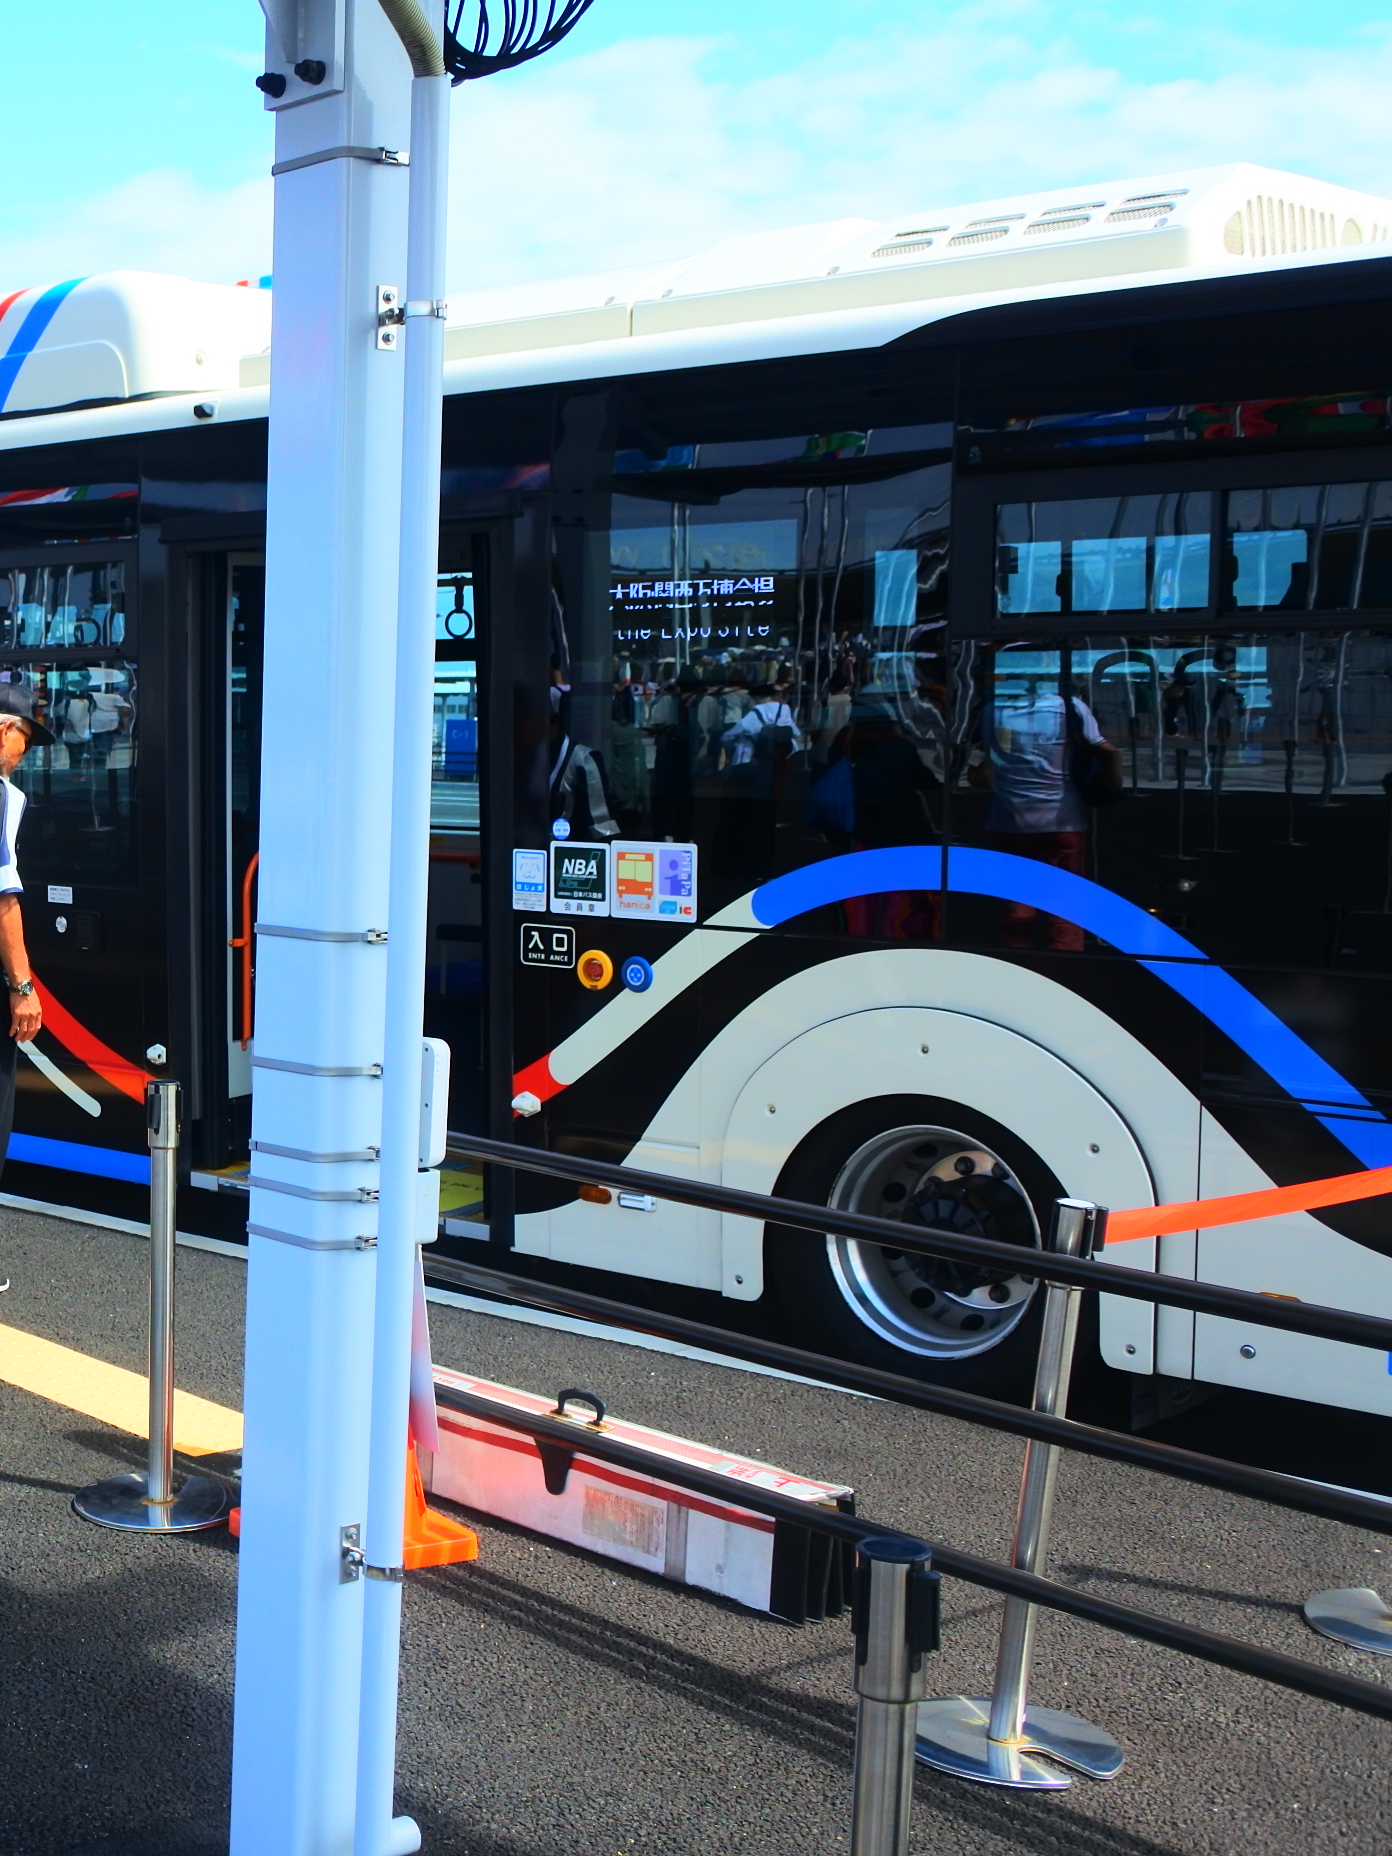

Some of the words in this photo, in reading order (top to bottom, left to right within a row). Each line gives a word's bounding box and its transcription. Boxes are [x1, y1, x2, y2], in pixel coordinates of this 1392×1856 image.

[562, 858, 598, 876] NBA
[681, 851, 692, 896] PiTaPa
[516, 883, 543, 892] ほじょ犬
[573, 890, 603, 899] 日本バス協会
[564, 901, 596, 912] 会員章
[619, 900, 651, 910] hanica
[528, 931, 568, 951] 入口
